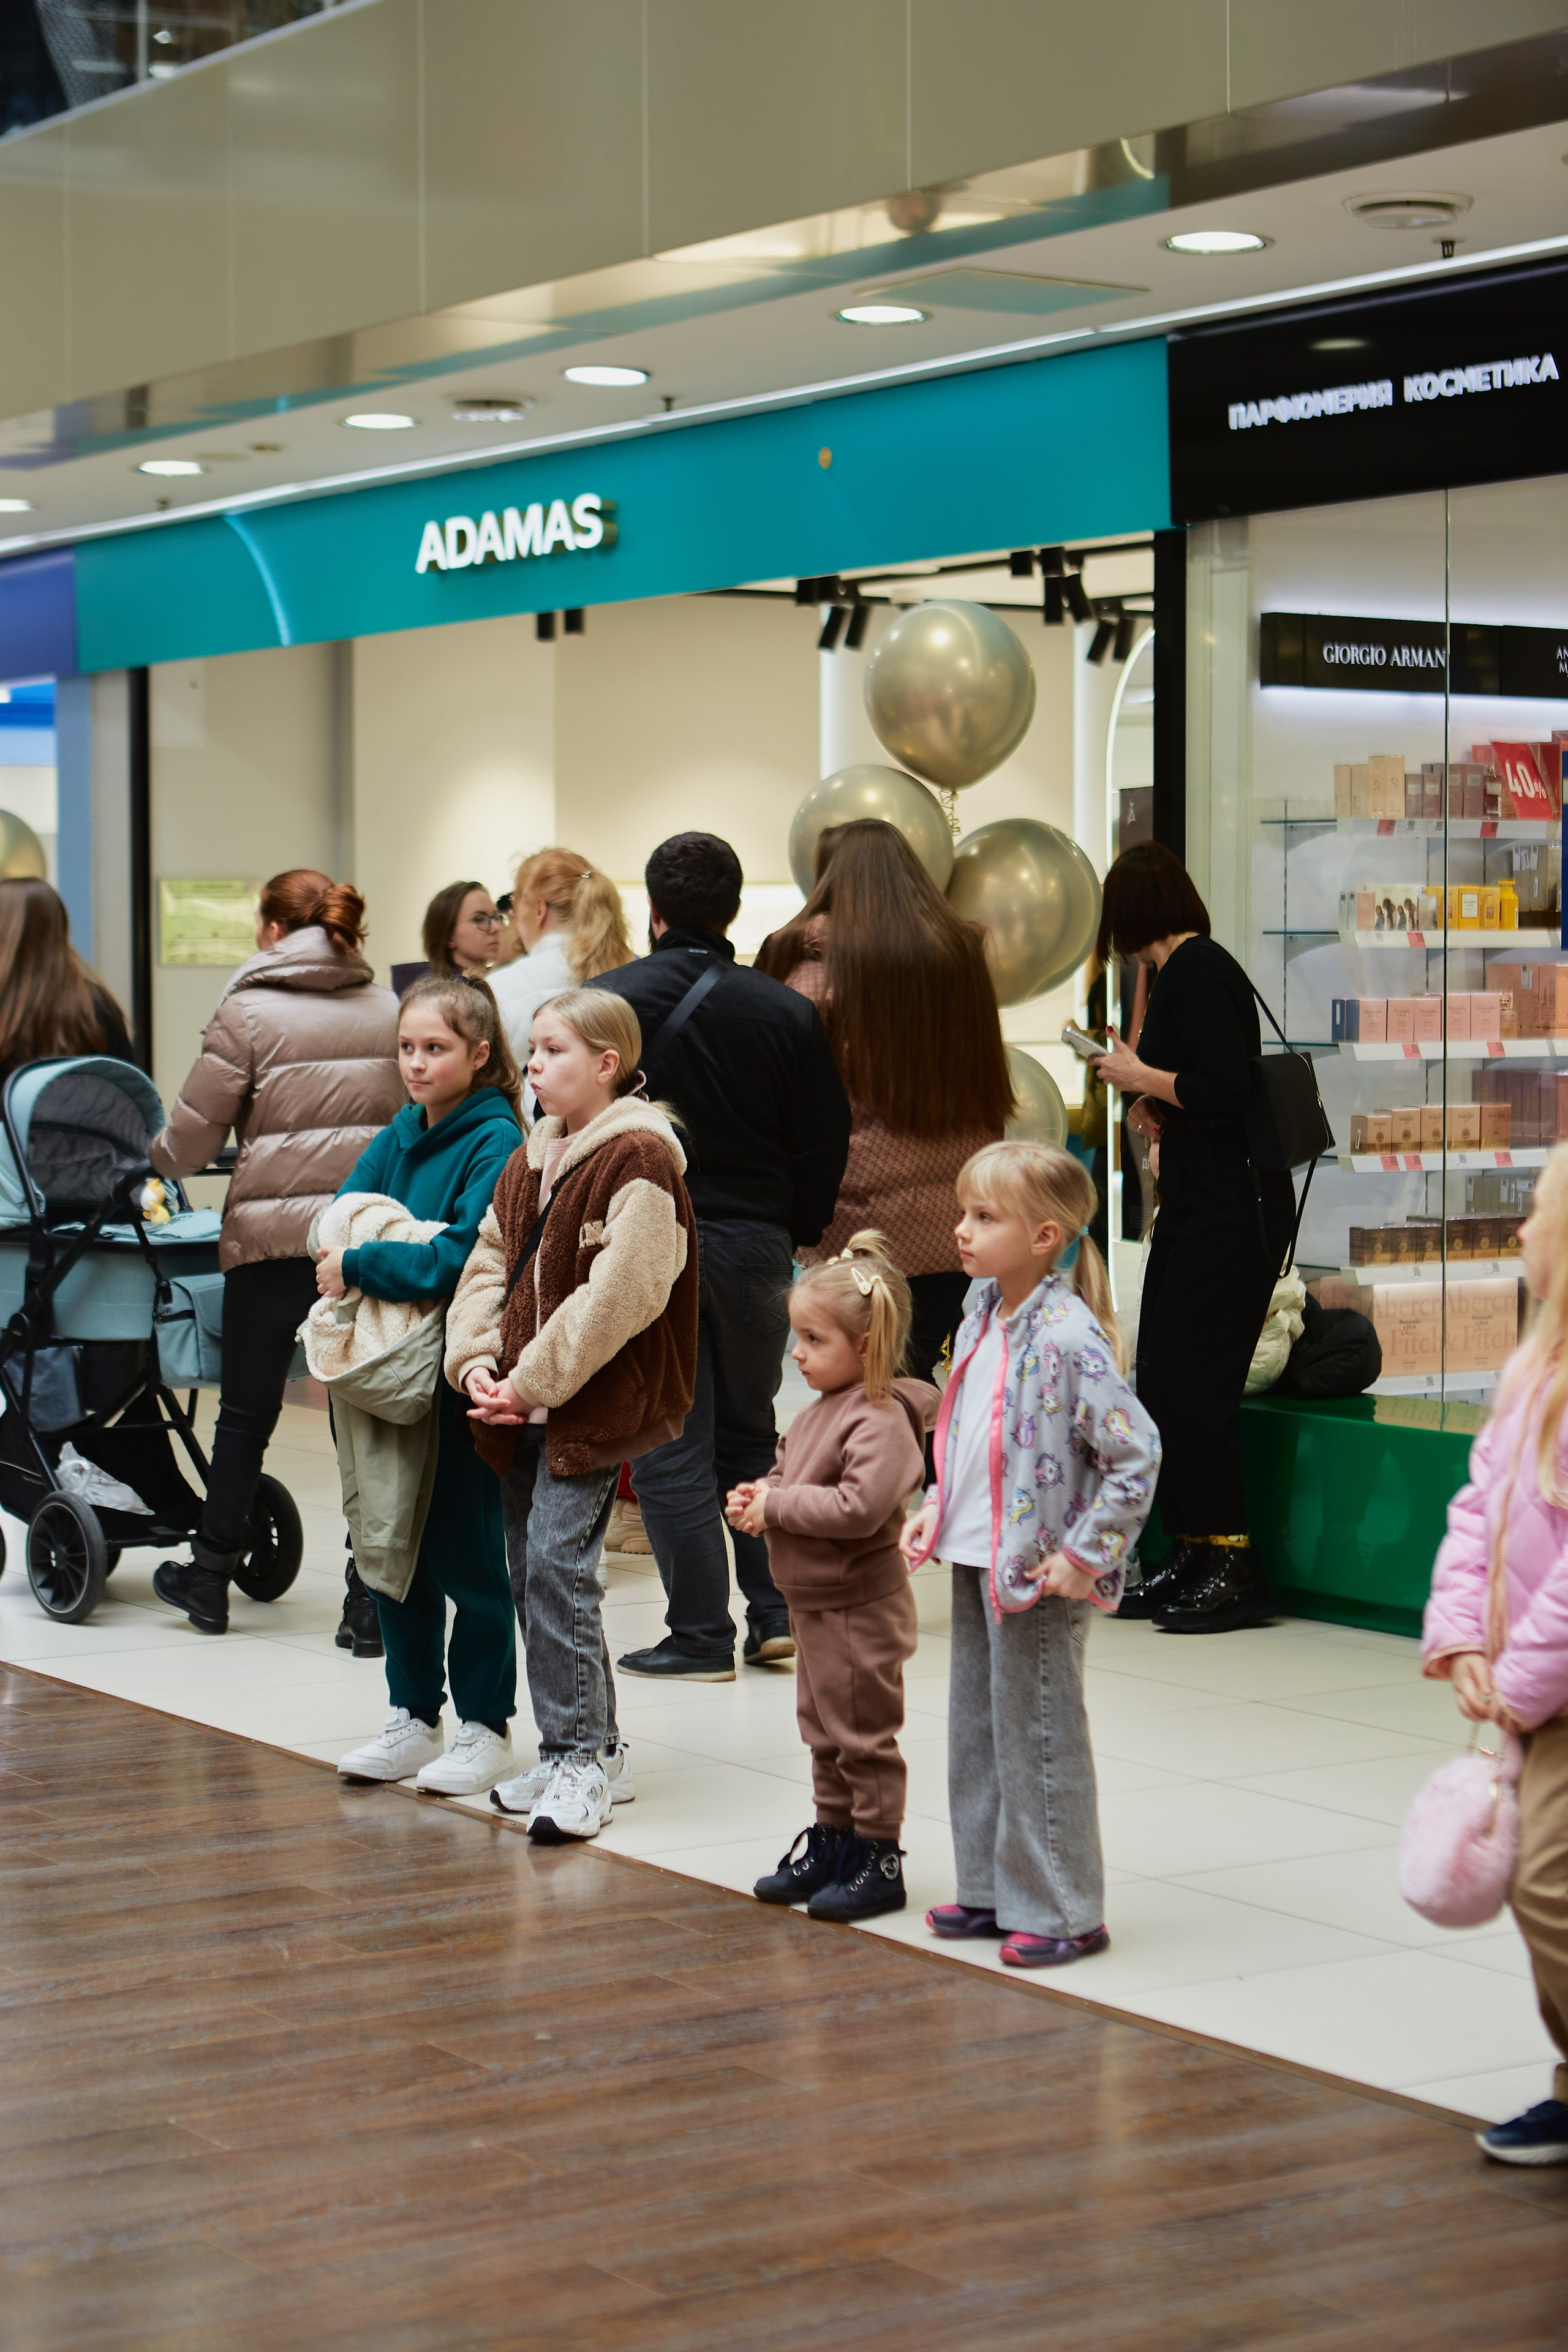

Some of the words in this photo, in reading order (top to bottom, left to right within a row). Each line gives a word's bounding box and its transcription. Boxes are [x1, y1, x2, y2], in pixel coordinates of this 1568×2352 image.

[1228, 378, 1393, 430] ПАРФЮМЕРИЯ
[1403, 353, 1559, 402] КОСМЕТИКА
[415, 492, 605, 575] ADAMAS
[1322, 643, 1387, 666] GIORGIO
[1390, 646, 1446, 668] ARMAN
[1505, 761, 1547, 799] 40%
[1373, 1289, 1442, 1318] Abercr
